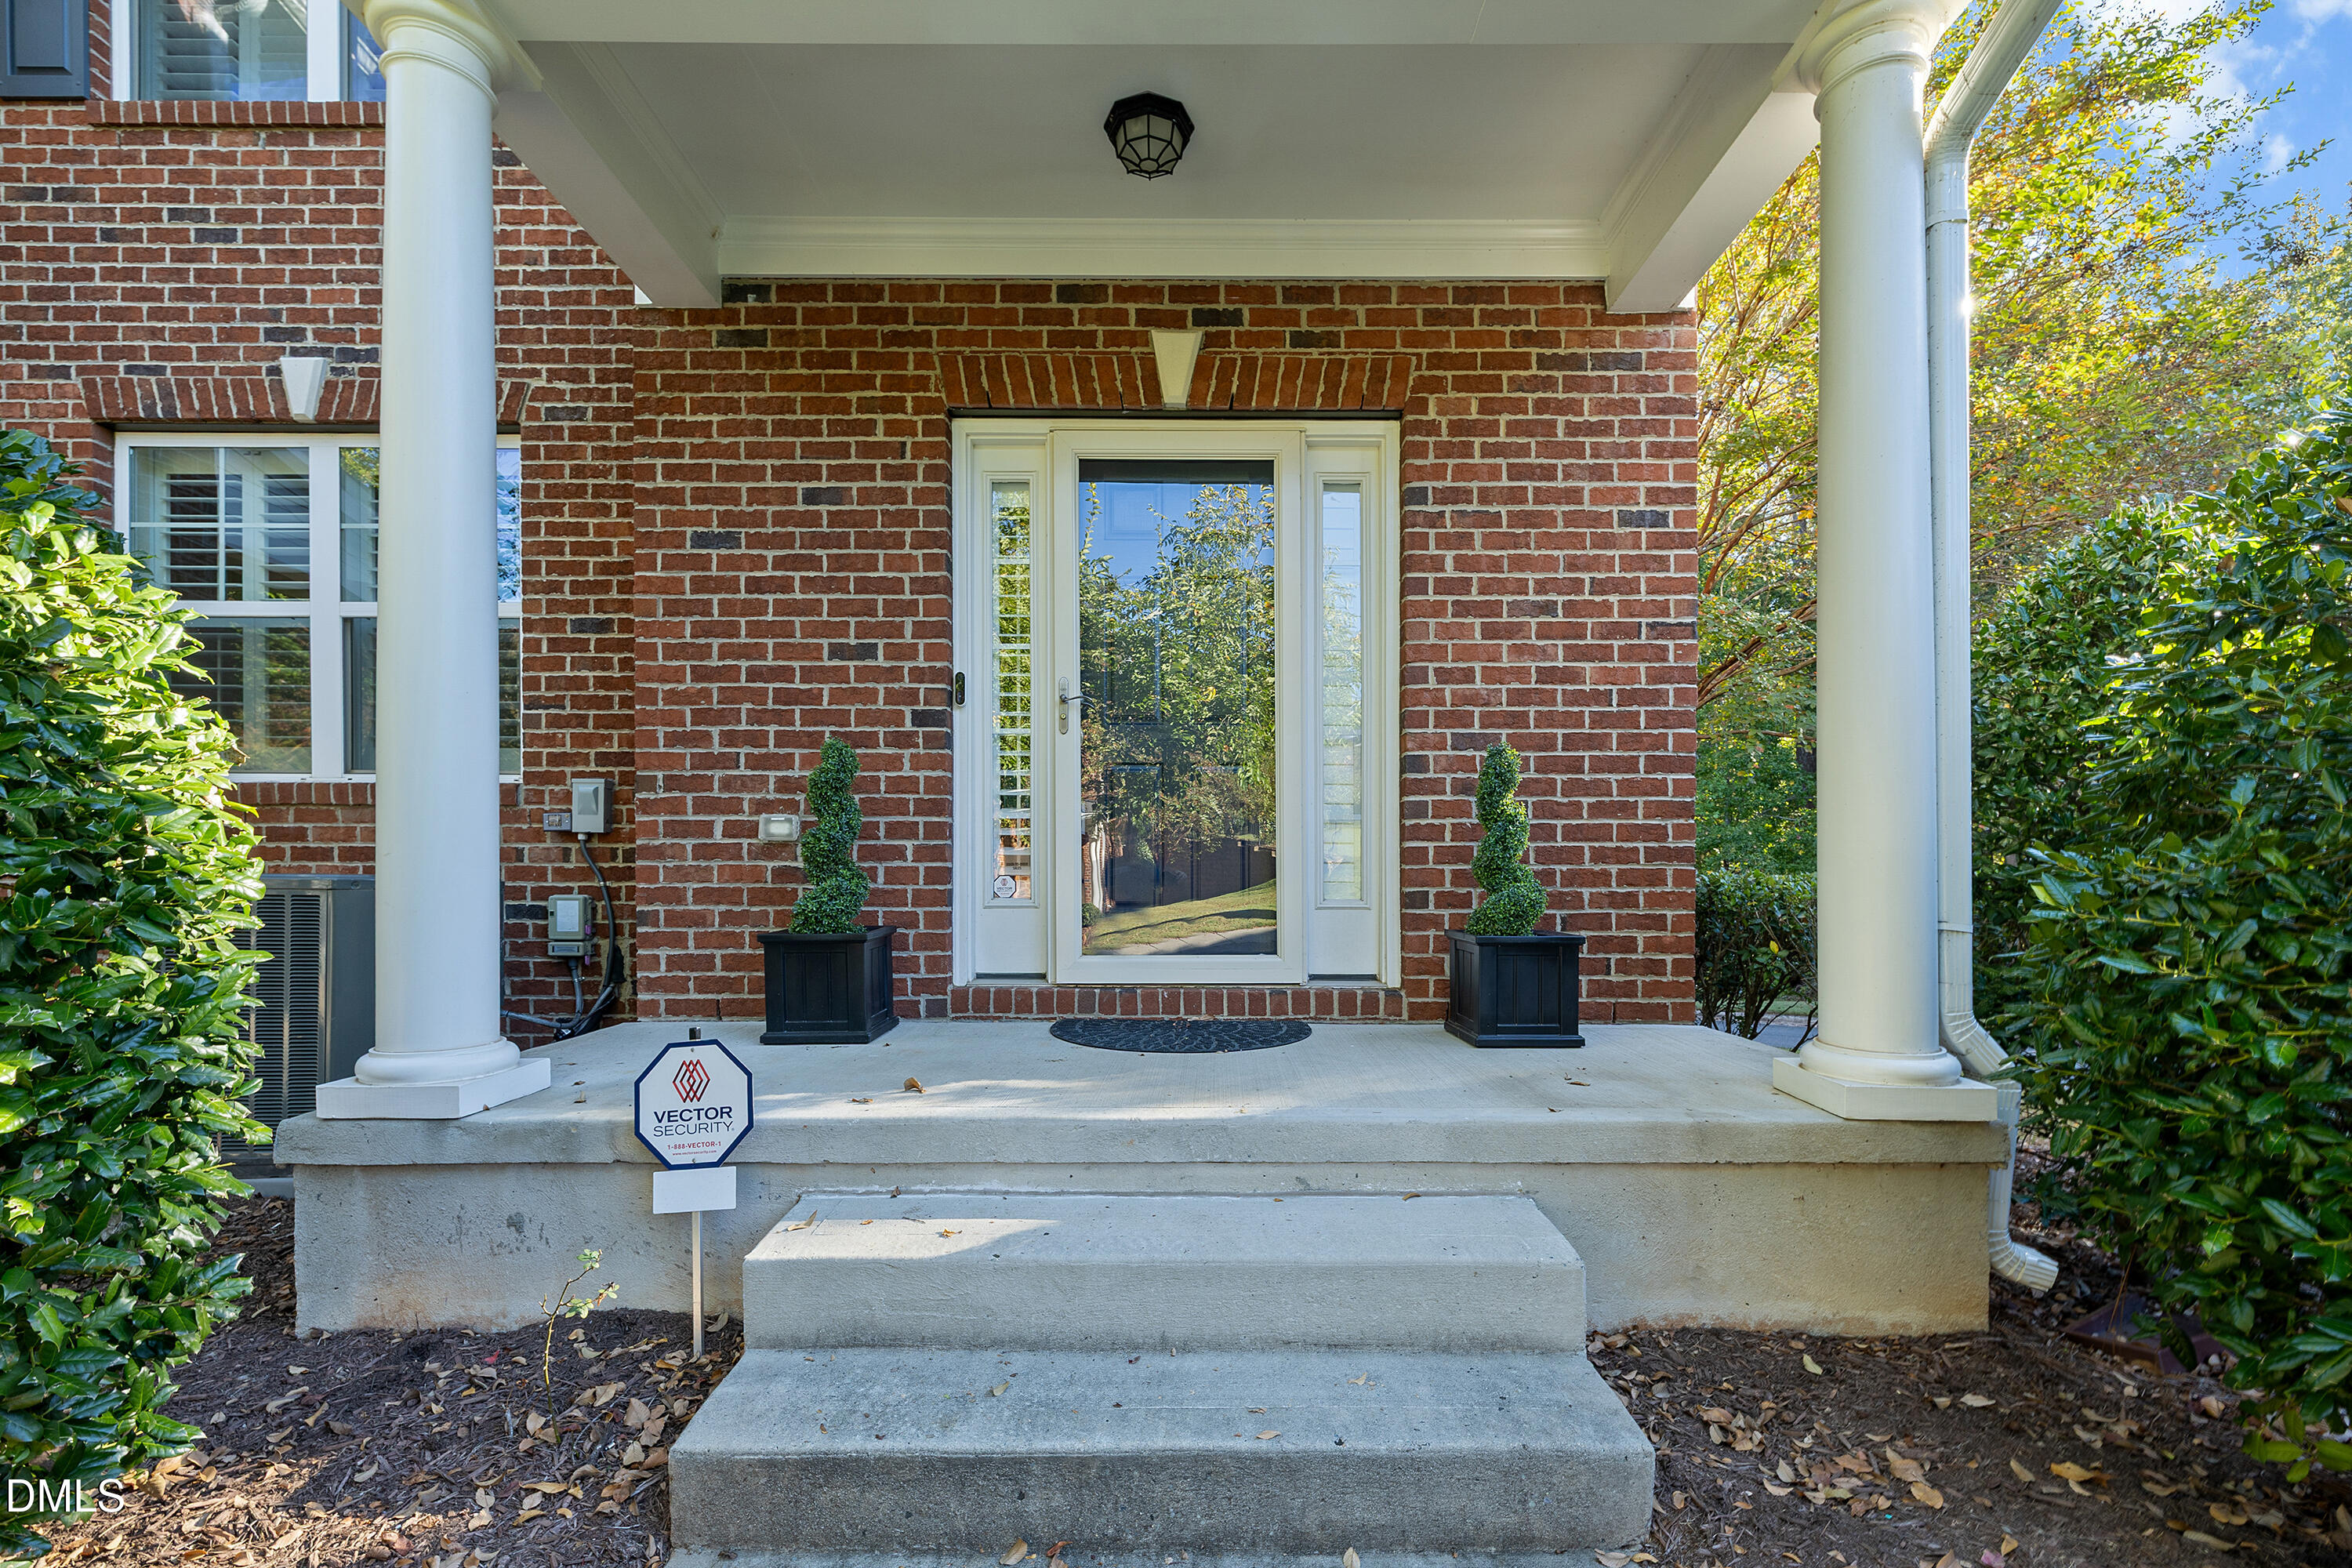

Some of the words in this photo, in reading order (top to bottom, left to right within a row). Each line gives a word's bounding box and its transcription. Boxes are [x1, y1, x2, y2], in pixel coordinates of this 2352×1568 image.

[653, 1106, 733, 1123] VECTOR
[653, 1121, 734, 1137] SECURITY
[667, 1141, 721, 1150] 1-888-VECTOR-1
